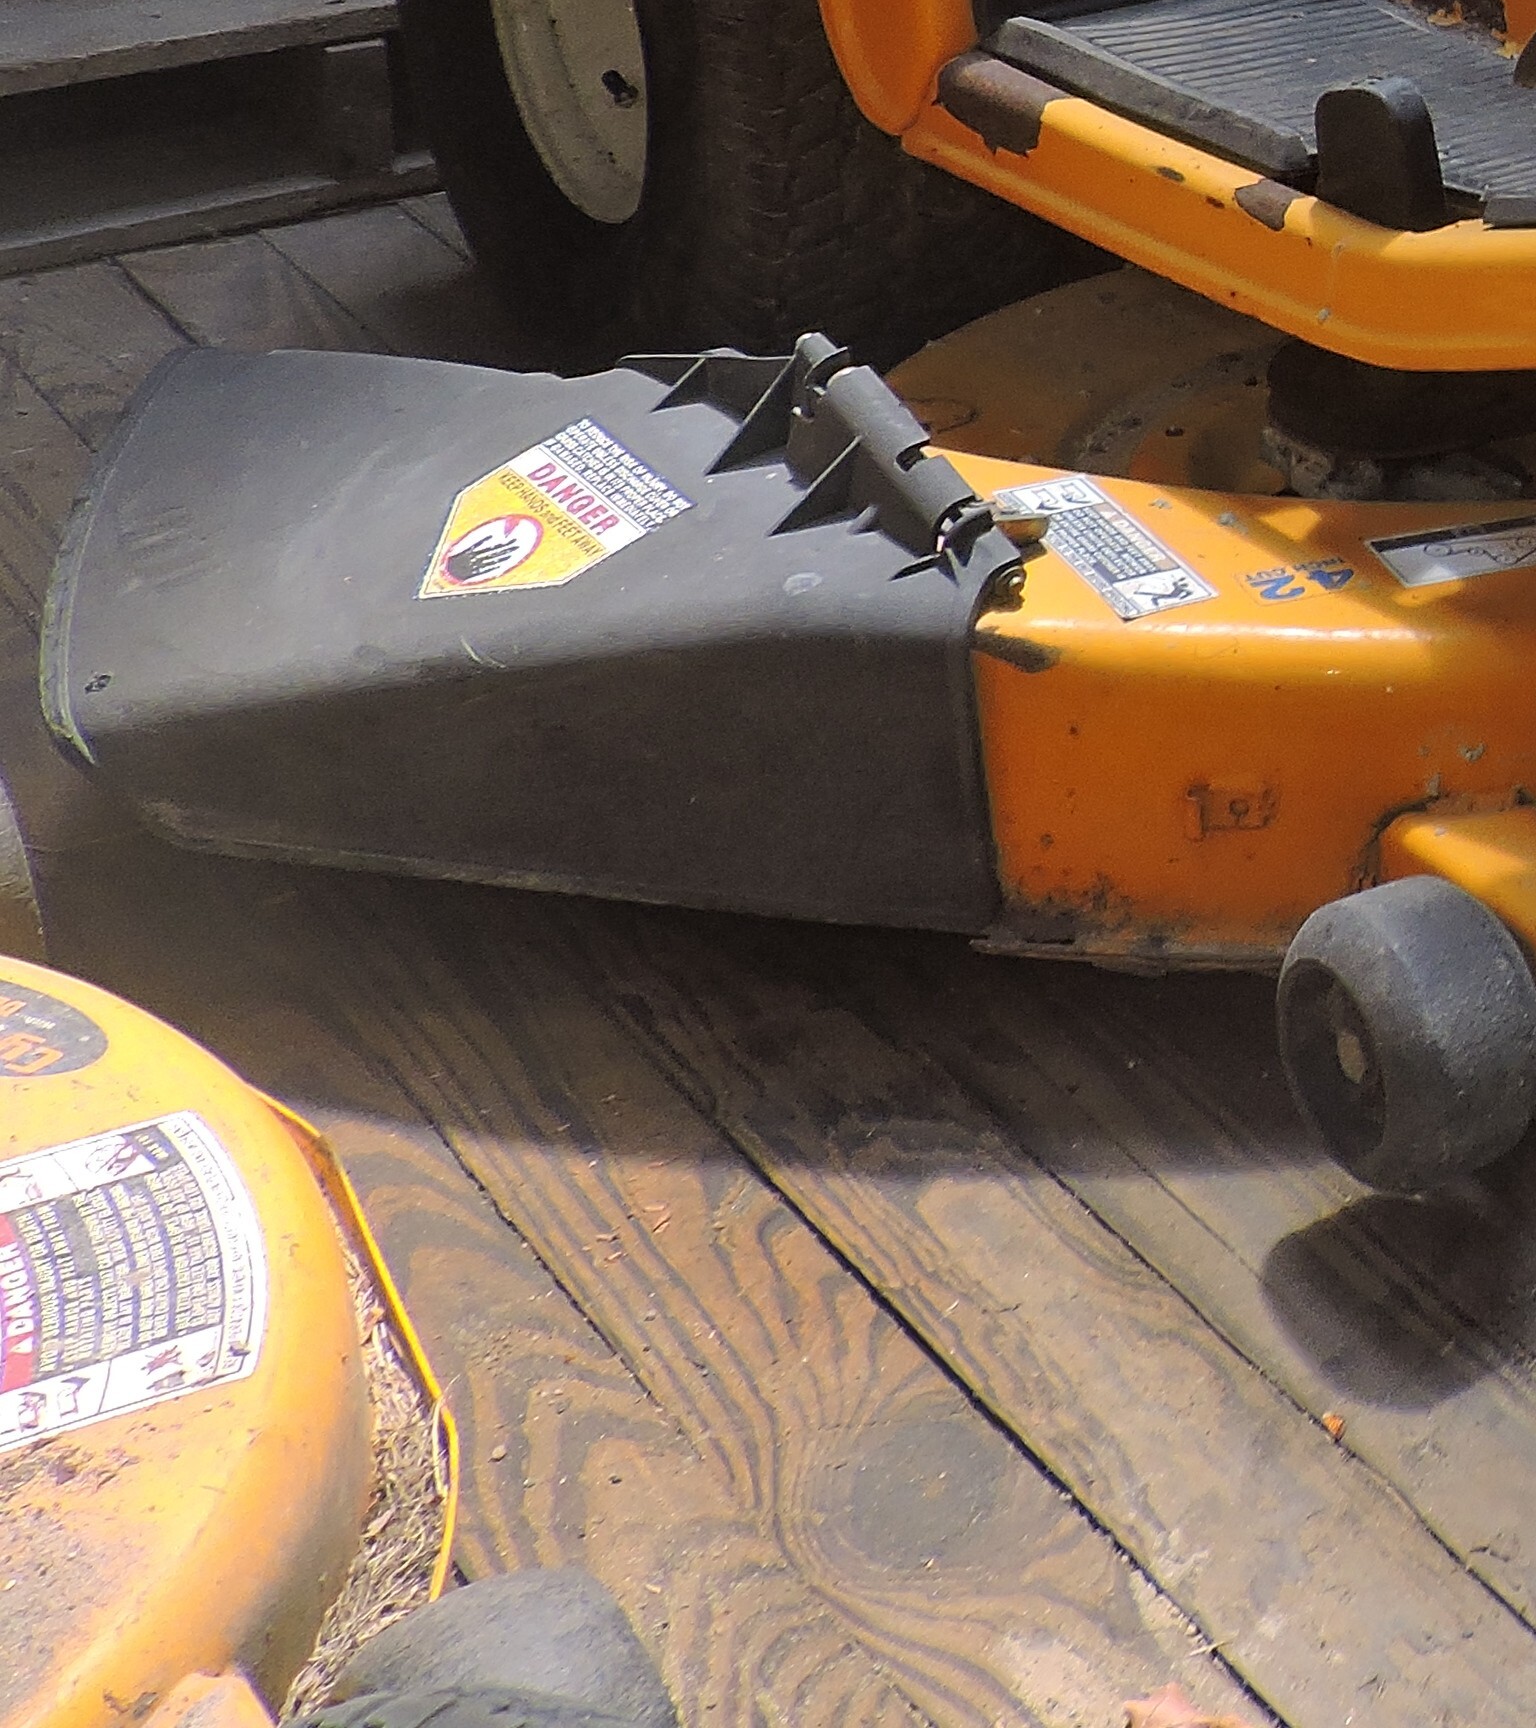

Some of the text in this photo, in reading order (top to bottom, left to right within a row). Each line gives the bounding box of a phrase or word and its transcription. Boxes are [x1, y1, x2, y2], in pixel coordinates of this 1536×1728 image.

[498, 472, 524, 497] KEEP
[518, 483, 547, 512] HANDS
[551, 516, 579, 542] FEET
[571, 531, 604, 557] AWAY
[527, 462, 620, 535] DANGER
[1250, 568, 1354, 600] 42
[0, 1240, 34, 1334] DANGER
